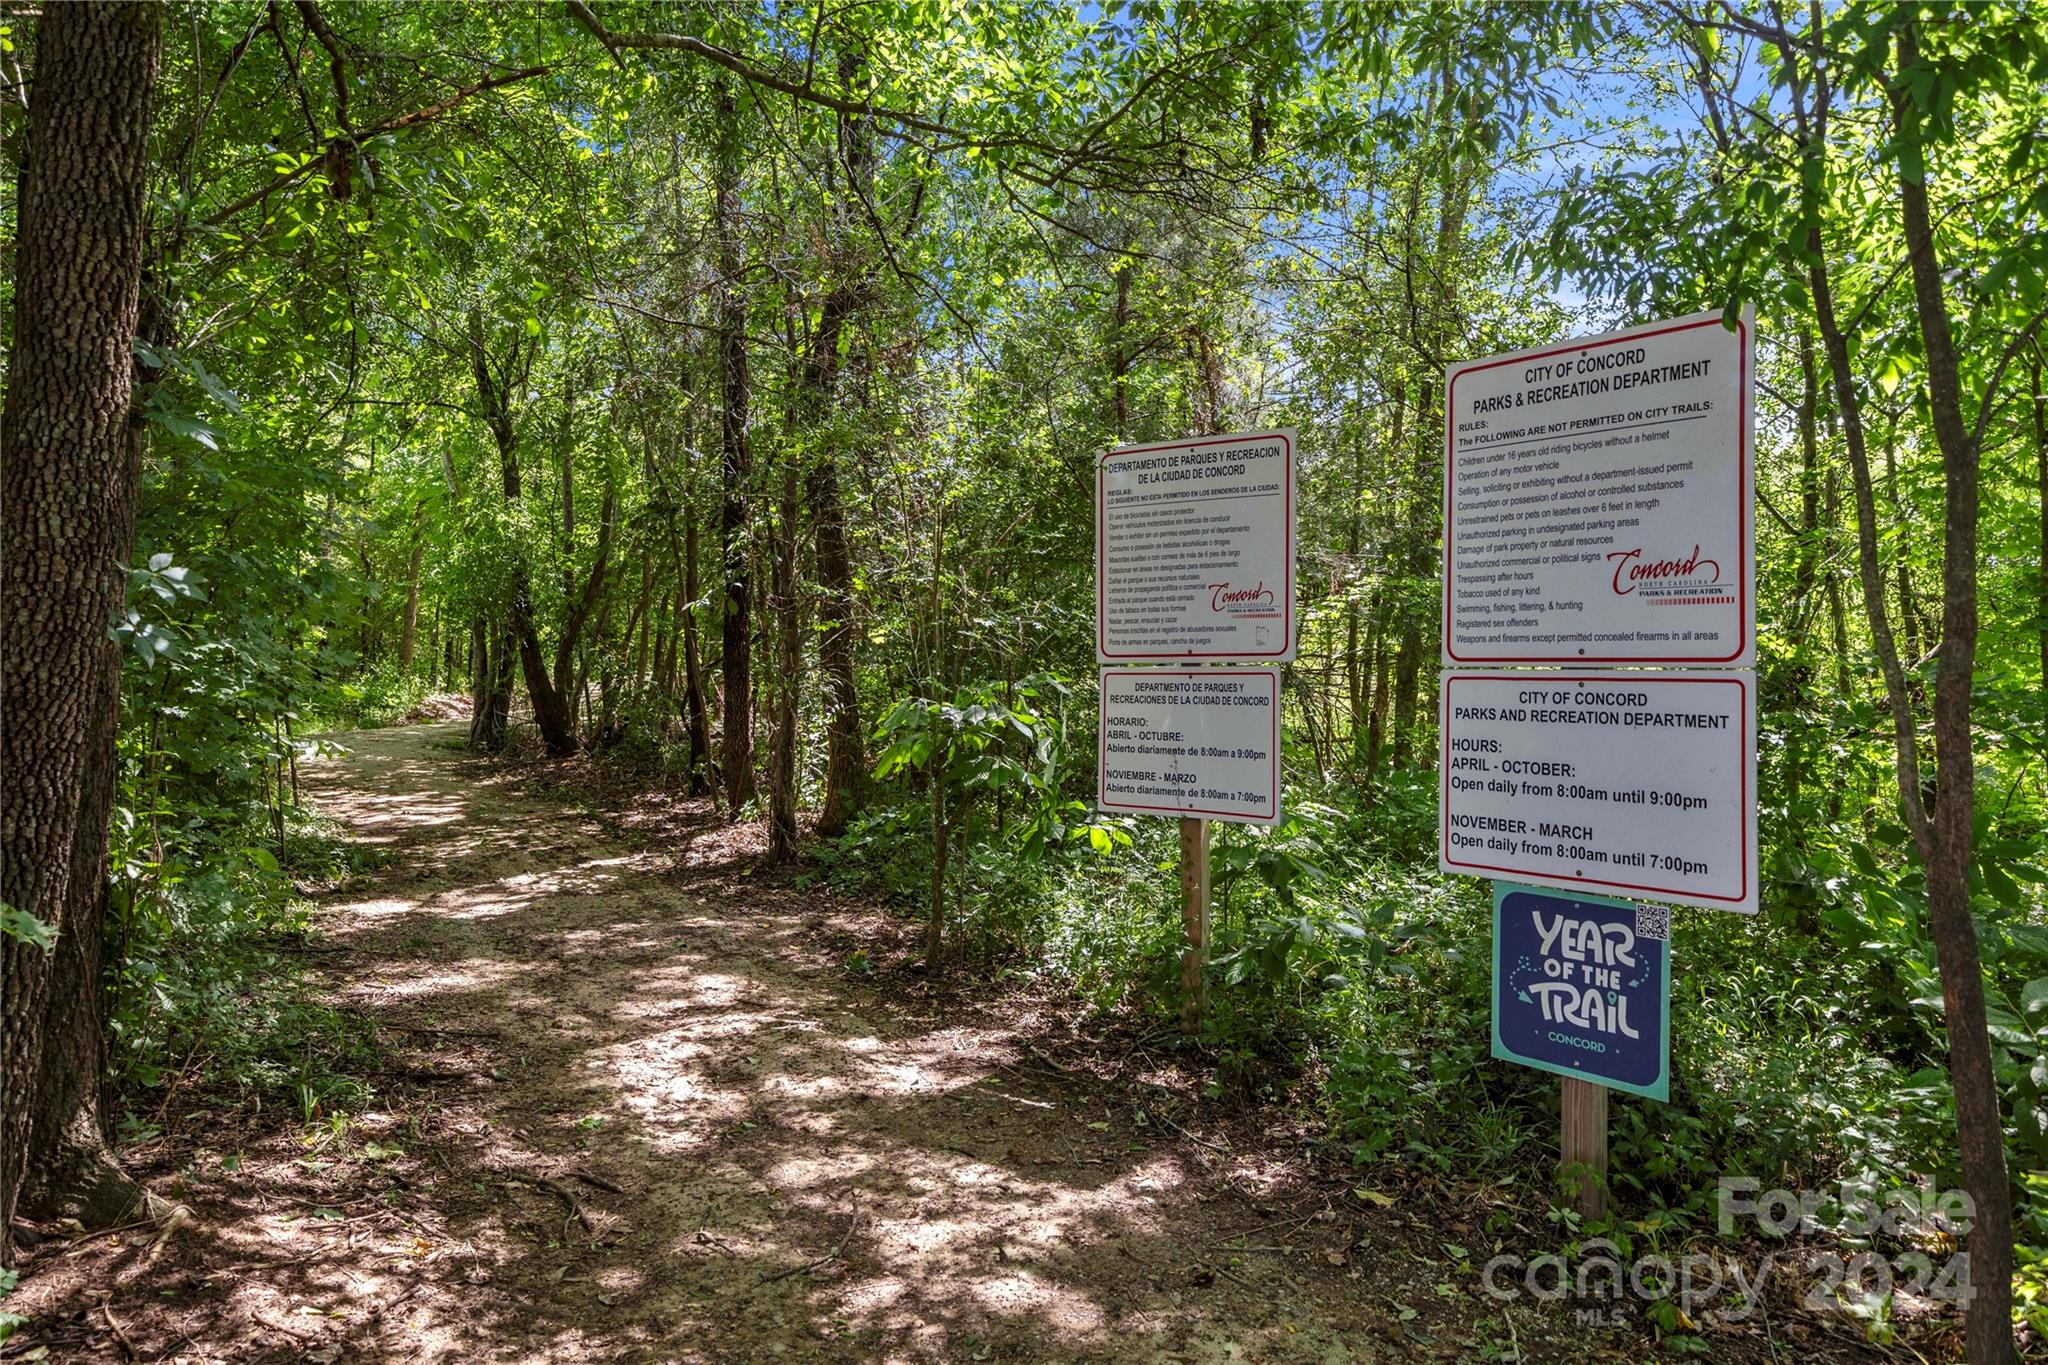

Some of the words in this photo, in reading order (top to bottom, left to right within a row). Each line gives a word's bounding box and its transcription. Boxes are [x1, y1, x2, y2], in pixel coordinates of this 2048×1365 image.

[1525, 365, 1552, 383] CITY
[1555, 361, 1573, 378] OF
[1576, 348, 1645, 374] CONCORD
[1473, 394, 1512, 414] PARKS
[1515, 392, 1524, 407] &
[1527, 377, 1609, 405] RECREATION
[1613, 359, 1711, 390] DEPARTMENT
[1458, 438, 1473, 446] The
[1474, 428, 1525, 444] FOLLOWING
[1527, 425, 1546, 436] ARE
[1548, 422, 1567, 432] NOT
[1569, 413, 1625, 429] PERMITTED
[1627, 410, 1642, 421] ON
[1645, 406, 1668, 418] CITY
[1671, 400, 1712, 414] TRAILS:
[1458, 420, 1488, 432] RULES:
[1458, 456, 1485, 467] Children
[1486, 453, 1506, 463] under
[1507, 450, 1516, 460] 16
[1517, 449, 1536, 461] years
[1537, 445, 1549, 456] old
[1550, 443, 1571, 454] riding
[1572, 439, 1602, 452] bicycles
[1604, 434, 1633, 447] without
[1634, 435, 1640, 443] a
[1641, 430, 1670, 442] helmet
[1108, 457, 1167, 473] DEPARTAMENTO
[1168, 456, 1179, 467] DE
[1180, 452, 1217, 465] PARQUES
[1218, 451, 1224, 462] Y
[1226, 446, 1279, 461] RECREACION
[1138, 473, 1148, 484] DE
[1150, 472, 1160, 483] LA
[1161, 469, 1190, 482] CIUDAD
[1192, 467, 1203, 479] DE
[1204, 464, 1245, 478] CONCORD
[1457, 513, 1499, 526] Unrestrained
[1500, 512, 1515, 523] pets
[1515, 512, 1524, 520] or
[1524, 509, 1540, 521] pets
[1552, 506, 1581, 516] leashes
[1582, 505, 1600, 514] over
[1601, 502, 1606, 512] 6
[1608, 501, 1624, 511] feet
[1625, 500, 1633, 510] in
[1634, 497, 1659, 510] length
[1456, 574, 1496, 584] Trespassing
[1496, 572, 1513, 581] after
[1513, 571, 1533, 580] hours
[1607, 544, 1719, 595] Concord
[1208, 580, 1273, 612] Concord
[1674, 588, 1723, 596] RECREATION
[1456, 603, 1491, 614] Swimming,
[1493, 602, 1517, 613] fishing,
[1518, 602, 1546, 612] littering,
[1547, 600, 1554, 610] &
[1555, 600, 1583, 611] hunting
[1456, 634, 1487, 645] Weapons
[1488, 634, 1501, 643] and
[1502, 633, 1530, 642] firearms
[1531, 633, 1556, 644] except
[1556, 632, 1592, 643] permitted
[1593, 631, 1634, 642] concealed
[1636, 631, 1670, 641] firearms
[1671, 630, 1680, 640] in
[1681, 630, 1691, 640] all
[1694, 632, 1718, 640] areas
[1134, 682, 1191, 692] DEPARTMENTO
[1192, 682, 1202, 692] DE
[1204, 682, 1238, 692] PARQUES
[1238, 683, 1244, 692] Y
[1110, 694, 1166, 704] RECREACIONES
[1168, 695, 1178, 704] DE
[1180, 695, 1191, 704] LA
[1192, 695, 1220, 705] CIUDAD
[1221, 696, 1231, 705] DE
[1232, 696, 1269, 706] CONCORD
[1519, 691, 1548, 704] CITY
[1552, 691, 1570, 704] OF
[1574, 692, 1647, 706] CONCORD
[1107, 716, 1148, 727] HORARIO:
[1455, 707, 1496, 720] PARKS
[1499, 708, 1526, 721] AND
[1530, 709, 1619, 725] RECREATION
[1624, 712, 1729, 728] DEPARTMENT
[1106, 730, 1132, 739] ABRIL
[1138, 730, 1183, 741] OCTUBRE:
[1452, 738, 1502, 753] HOURS:
[1106, 743, 1136, 753] Abierto
[1187, 746, 1198, 756] de
[1200, 746, 1229, 757] 8:00am
[1237, 748, 1266, 761] 9:00pm
[1106, 769, 1156, 781] NOVIEMBRE
[1164, 772, 1196, 783] MARZO
[1451, 756, 1490, 771] APRIL
[1501, 760, 1575, 777] OCTOBER:
[1105, 782, 1135, 793] Abierto
[1187, 788, 1198, 797] de
[1200, 788, 1228, 800] 8:00am
[1237, 791, 1266, 804] 7:00pm
[1451, 776, 1483, 792] Open
[1487, 778, 1518, 796] daily
[1521, 781, 1552, 796] from
[1556, 783, 1607, 800] 8:00am
[1612, 790, 1644, 804] until
[1649, 790, 1707, 810] 9:00pm
[1451, 814, 1526, 834] NOVEMBER
[1539, 822, 1592, 840] MARCH
[1451, 832, 1483, 848] Open
[1487, 836, 1518, 855] daily
[1521, 839, 1552, 856] from
[1556, 843, 1607, 862] 8:00am
[1612, 852, 1644, 867] until
[1650, 854, 1707, 875] 7:00pm
[1532, 911, 1635, 968] YEAR
[1544, 958, 1574, 980] OF
[1582, 964, 1621, 990] THE
[1548, 1031, 1605, 1053] CONCORD
